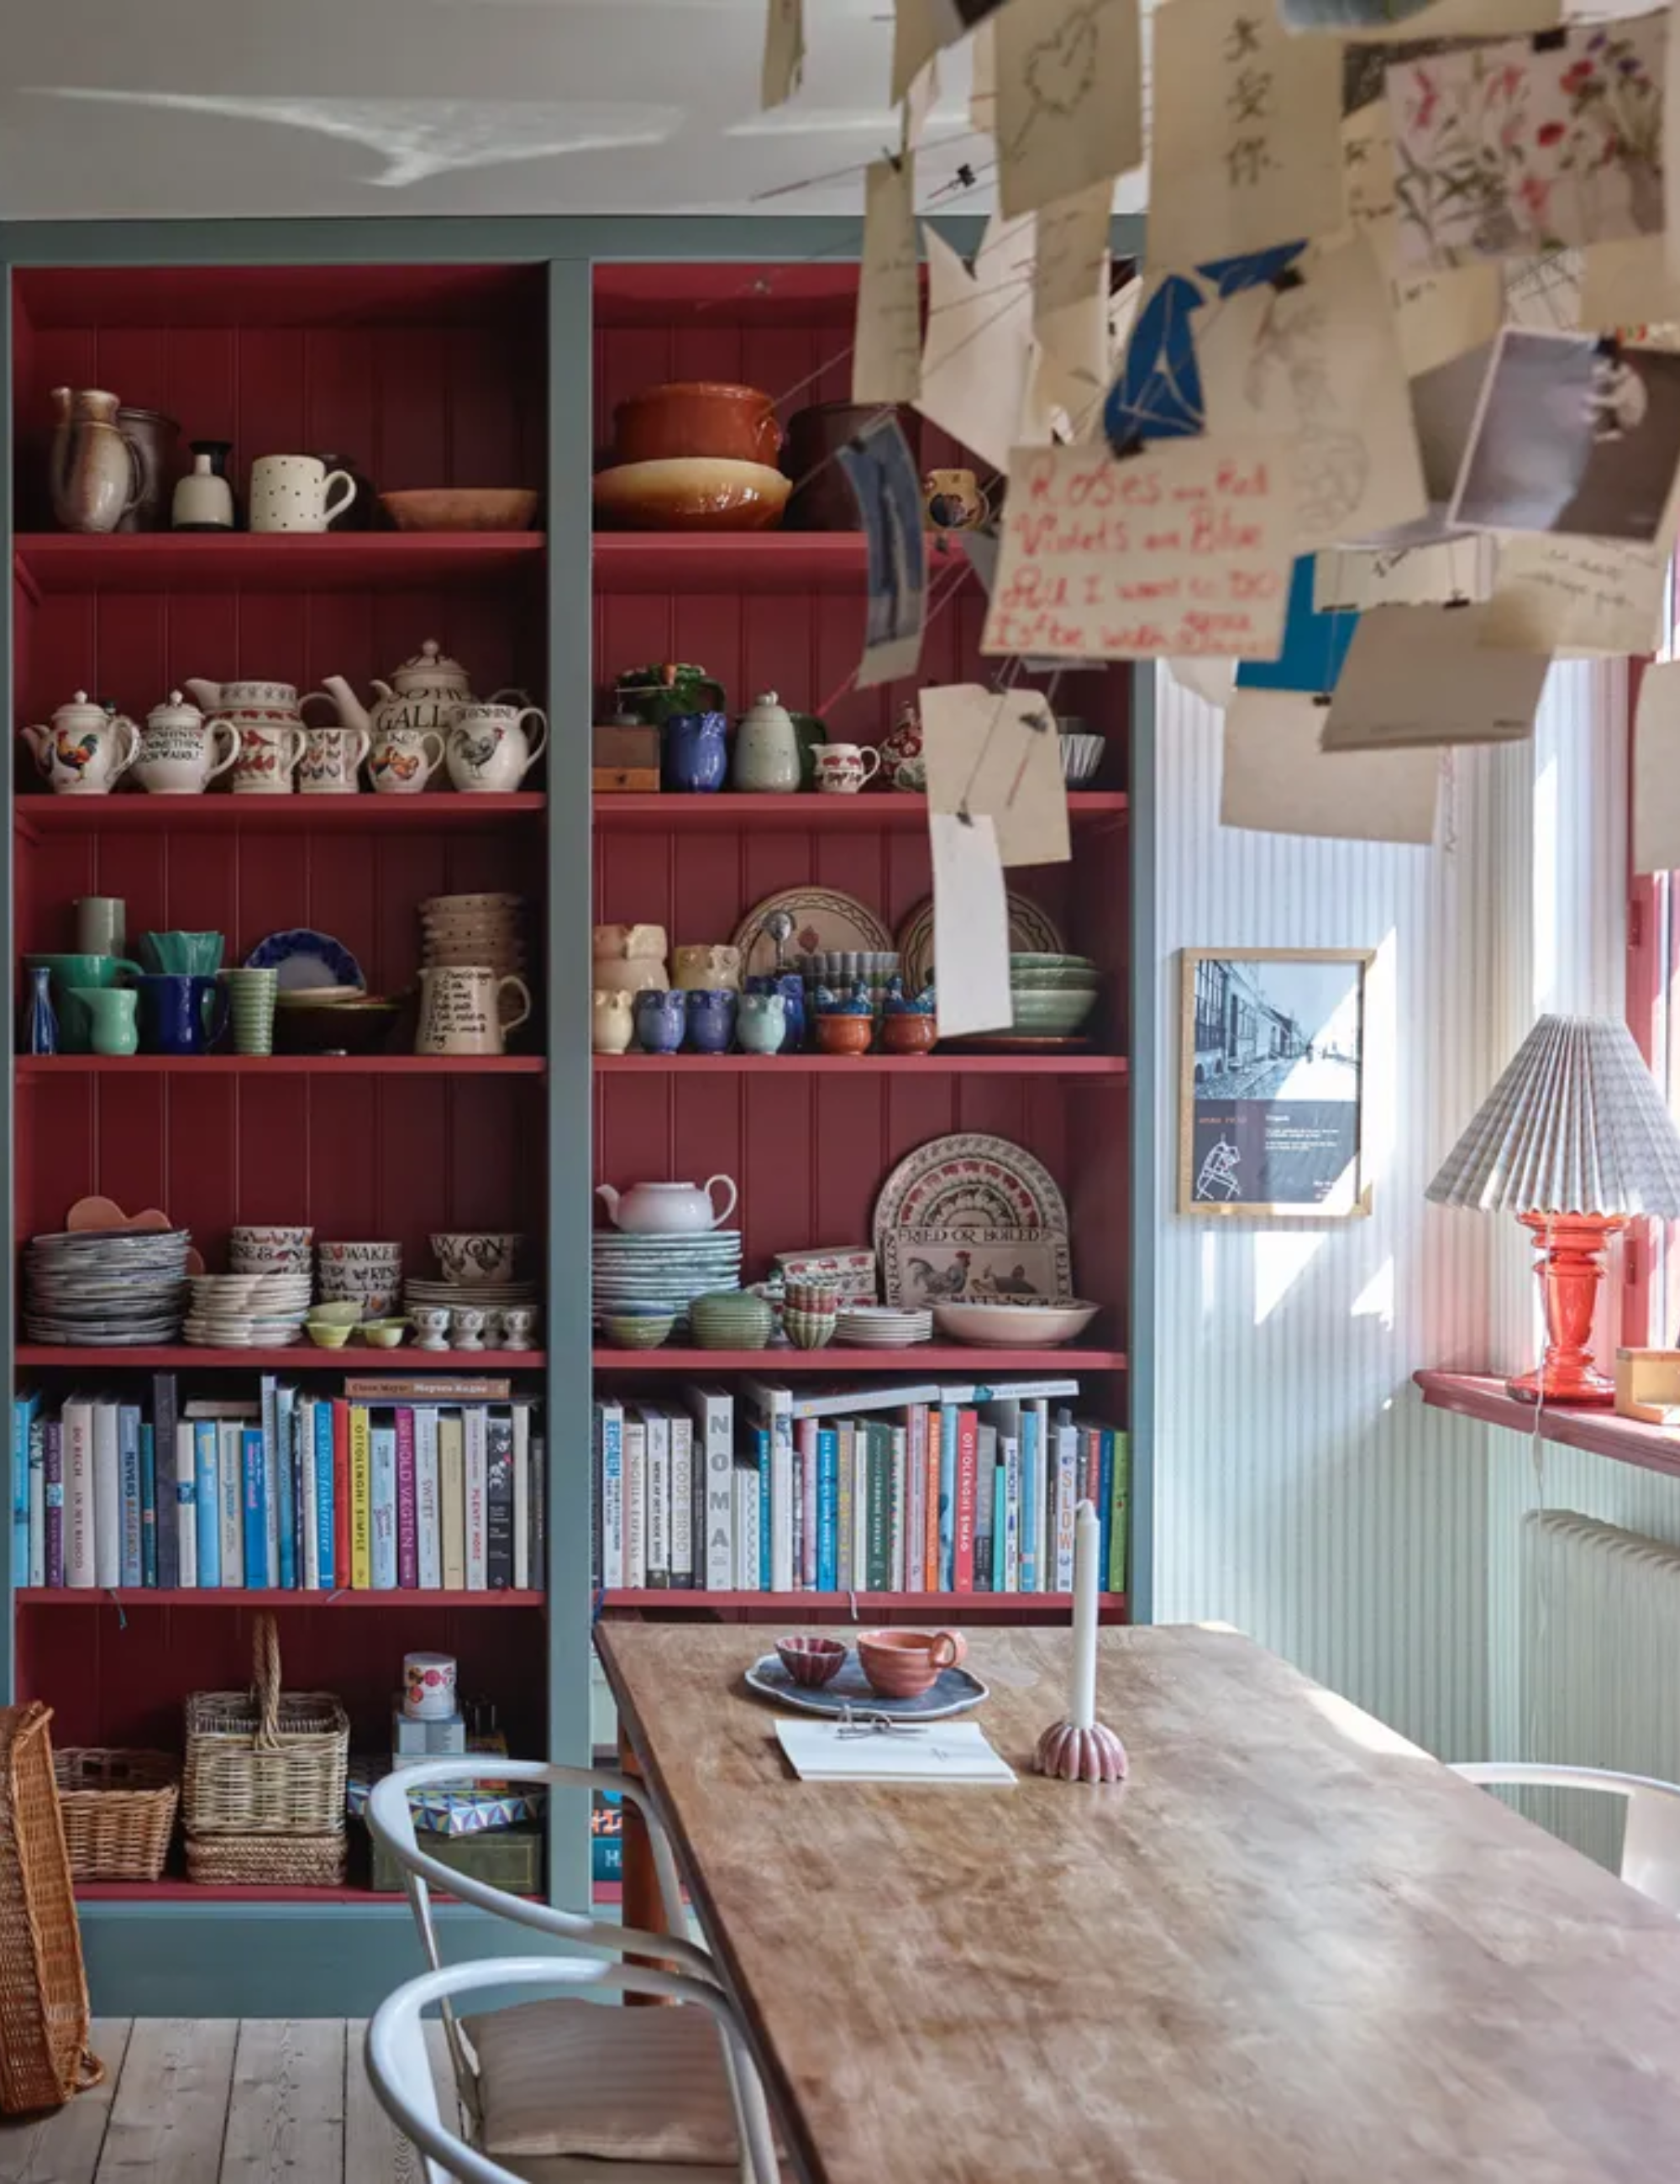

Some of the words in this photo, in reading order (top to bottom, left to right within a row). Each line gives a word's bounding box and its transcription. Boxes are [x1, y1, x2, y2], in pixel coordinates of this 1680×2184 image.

[898, 1228, 947, 1244] FRIED
[951, 1228, 982, 1246] OR
[354, 1425, 364, 1502] OTTOLENGHI
[605, 1419, 621, 1478] JERUSALEM
[962, 1432, 972, 1510] OTTOLENGHI
[711, 1415, 729, 1548] NOMA
[356, 1509, 365, 1552] SIMPLE
[471, 1488, 480, 1527] PLENTY
[74, 1529, 83, 1569] BLOOD
